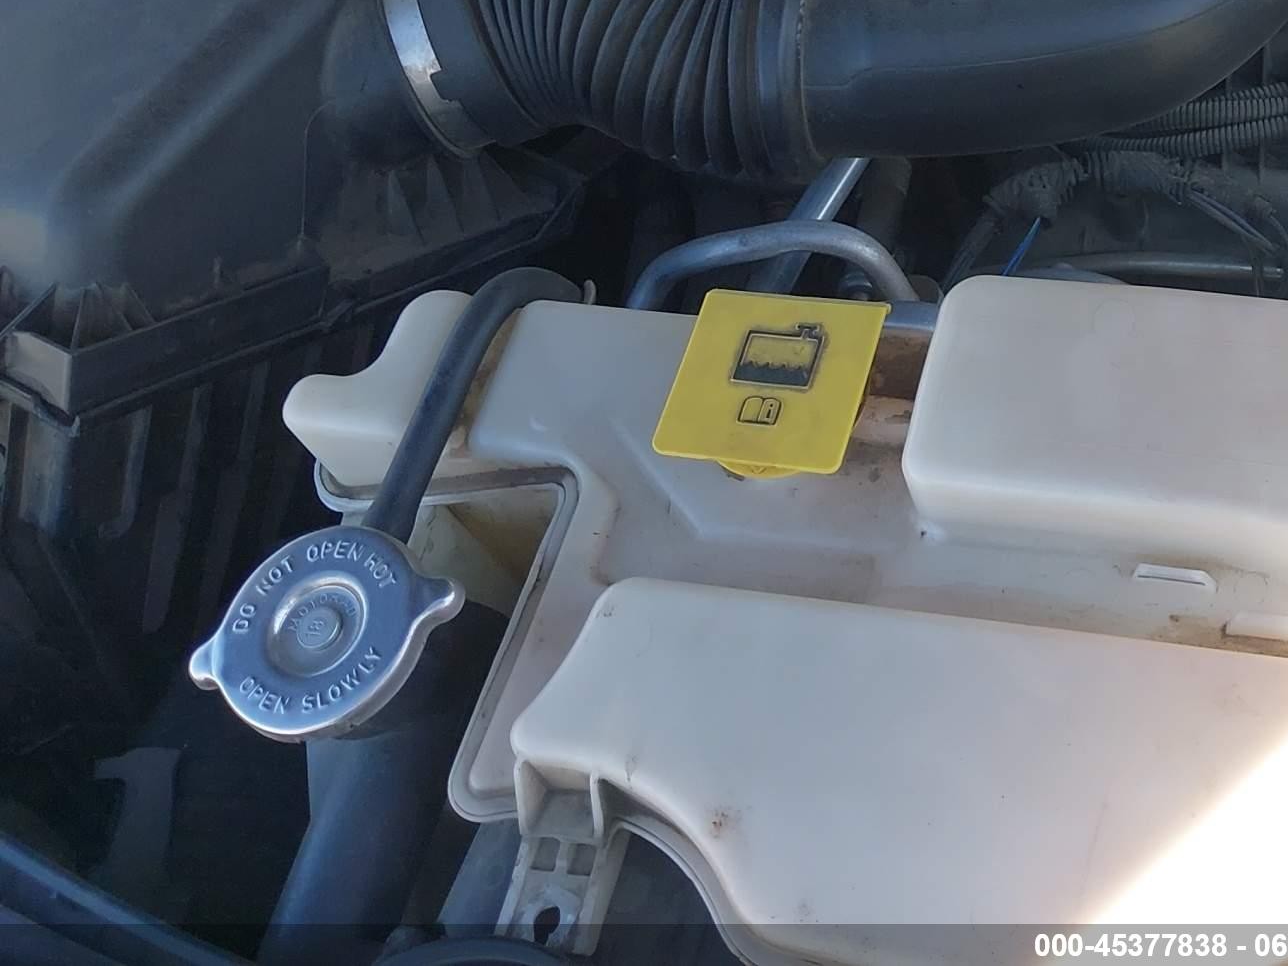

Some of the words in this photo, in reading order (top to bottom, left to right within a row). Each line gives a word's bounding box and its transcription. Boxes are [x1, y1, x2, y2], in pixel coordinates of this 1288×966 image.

[232, 604, 257, 635] DO
[255, 556, 295, 597] NOT
[306, 541, 364, 563] OPEN
[364, 552, 397, 588] HOT
[239, 676, 291, 715] OPEN
[301, 646, 384, 714] SLOWLY
